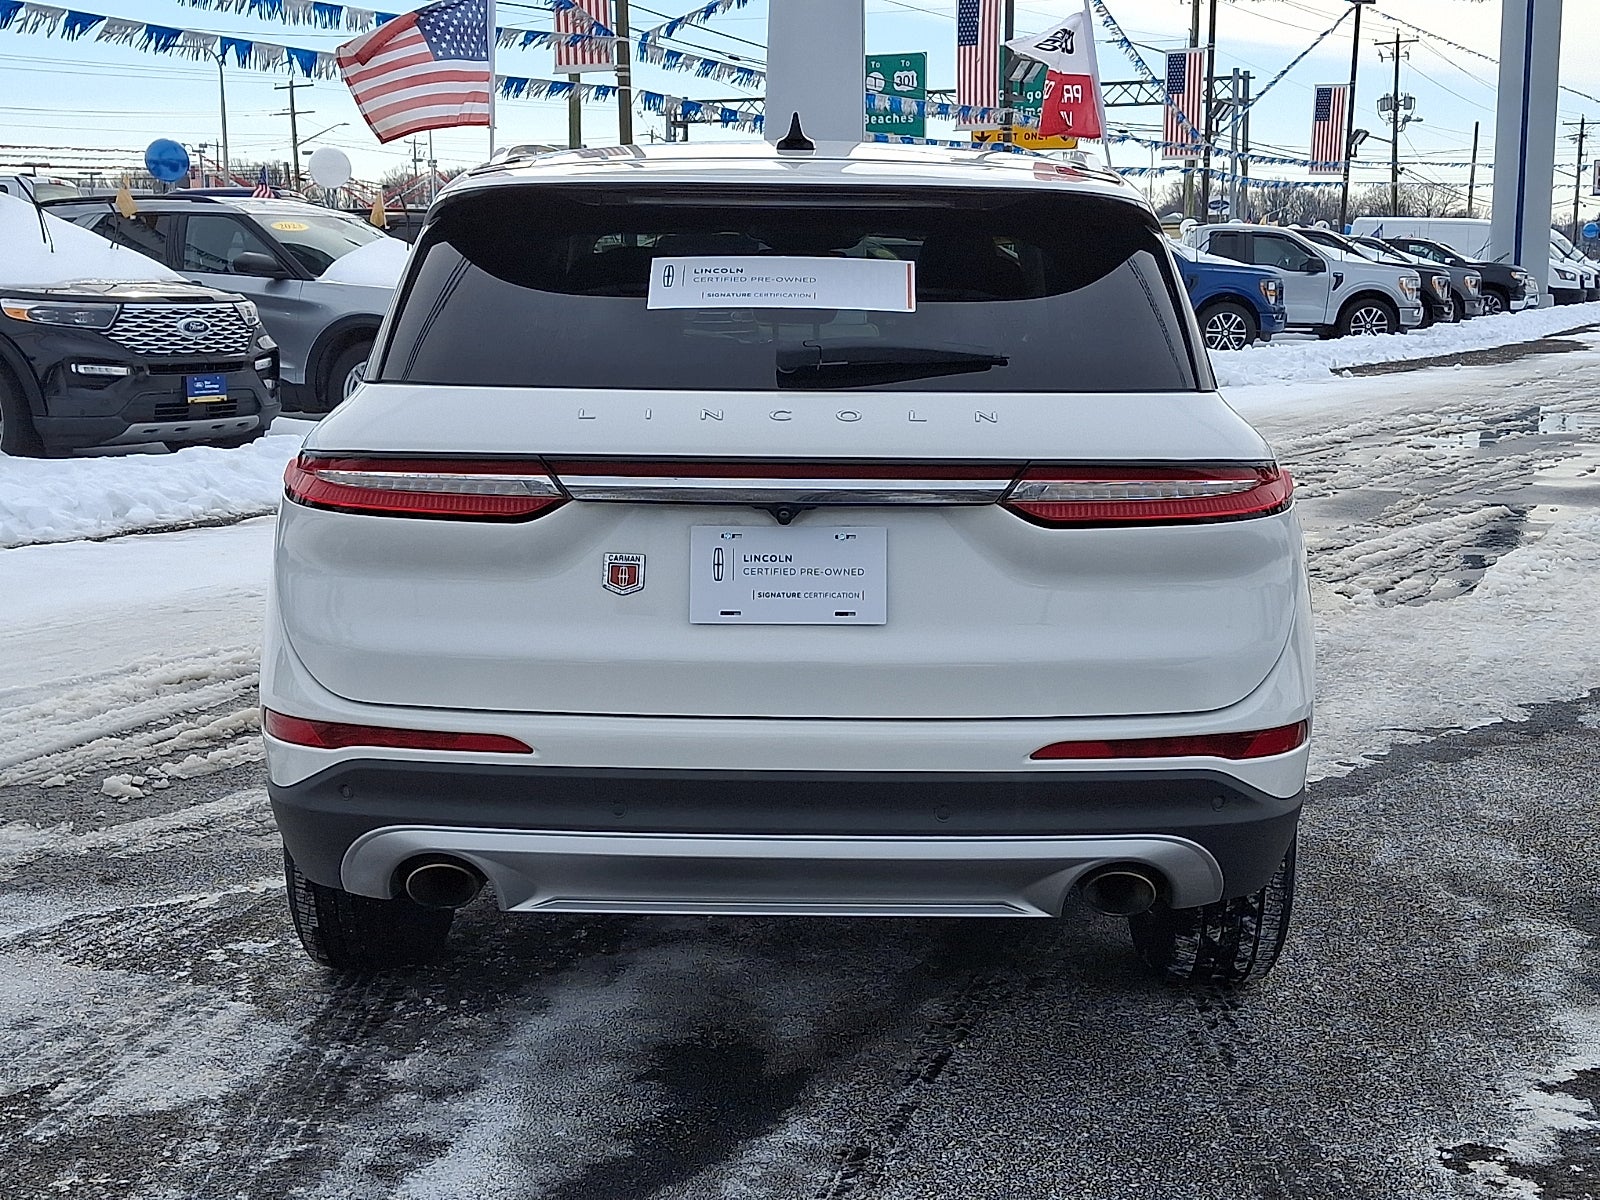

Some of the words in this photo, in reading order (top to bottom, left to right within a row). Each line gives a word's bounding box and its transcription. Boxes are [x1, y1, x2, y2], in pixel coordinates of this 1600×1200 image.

[870, 60, 881, 69] To
[900, 59, 911, 68] To
[895, 73, 915, 87] 301
[693, 267, 744, 275] LINCOLN
[693, 276, 748, 284] CERTIFIED
[750, 276, 817, 284] PRE-OWNED
[577, 407, 998, 424] LINCOLN
[608, 554, 641, 563] CARMAN
[743, 554, 793, 563] LINCOLN
[743, 567, 797, 576] CERTIFIED
[800, 567, 865, 577] PRE-OWNED
[757, 591, 802, 599] SIGNATURE
[803, 591, 860, 599] CERTIFICATION
